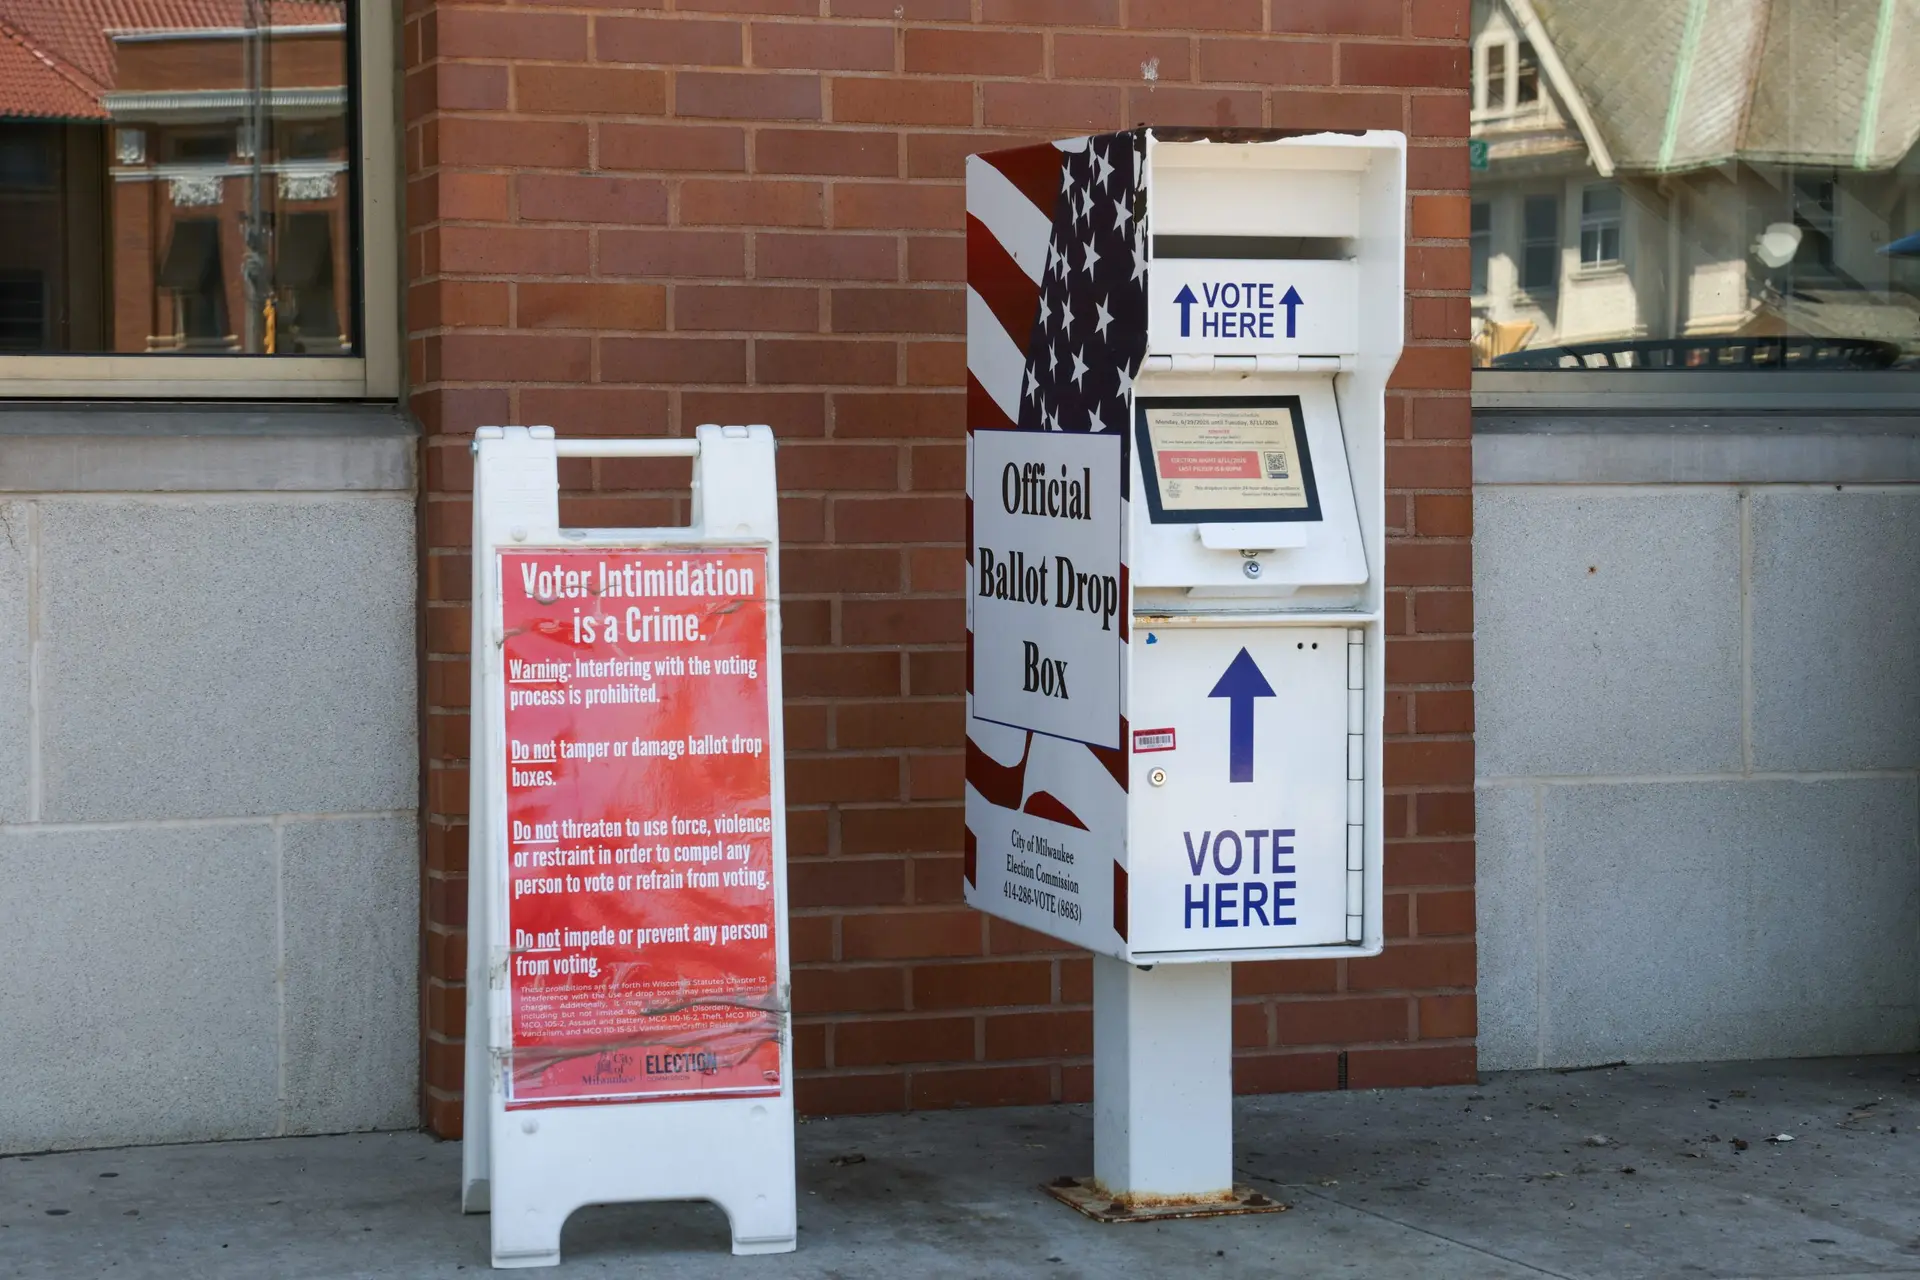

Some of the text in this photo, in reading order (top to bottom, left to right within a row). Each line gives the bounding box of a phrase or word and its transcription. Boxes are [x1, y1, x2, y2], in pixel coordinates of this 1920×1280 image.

[1202, 282, 1274, 309] VOTE
[1202, 312, 1274, 338] HERE
[1002, 462, 1092, 520] Official
[521, 560, 754, 598] Voter Intimidation
[979, 547, 1118, 631] Ballot Drop
[574, 606, 706, 643] is a Crime.
[510, 655, 757, 683] Warning: Interfering with the voting
[1023, 640, 1070, 700] Box
[510, 683, 660, 710] process is prohibited.
[512, 734, 762, 762] Do not tamper or damage ballot drop
[512, 768, 556, 787] boxes.
[514, 814, 771, 840] Do not threaten to use force, violence
[514, 840, 751, 868] or restraint in order to compel any
[1012, 829, 1074, 864] City of Milwaukee
[1183, 829, 1296, 876] VOTE
[515, 867, 770, 900] person to vote or refrain from voting.
[1006, 854, 1079, 894] Election Commission
[1004, 880, 1082, 925] 414-286-VOTE (8683)
[1184, 881, 1296, 928] HERE
[516, 923, 768, 950] Do not impede or prevent any person
[516, 954, 601, 978] from voting.
[521, 994, 568, 1002] Interference
[624, 990, 633, 998] of
[636, 990, 654, 998] drop
[682, 988, 698, 996] may
[702, 986, 722, 994] result
[546, 984, 592, 994] prohibitions
[693, 978, 724, 986] Statutes
[726, 977, 756, 985] Chapter
[522, 1012, 558, 1020] including
[562, 1010, 575, 1018] but
[596, 1008, 624, 1016] limited
[692, 1004, 730, 1012] Disorderly
[569, 1019, 596, 1027] Assault
[616, 1016, 644, 1026] Battery,
[522, 1028, 564, 1038] Vandalism,
[566, 1028, 580, 1036] and
[614, 1053, 634, 1066] City
[614, 1064, 624, 1074] of
[646, 1052, 717, 1074] ELECTION
[581, 1074, 636, 1086] Milwaukee
